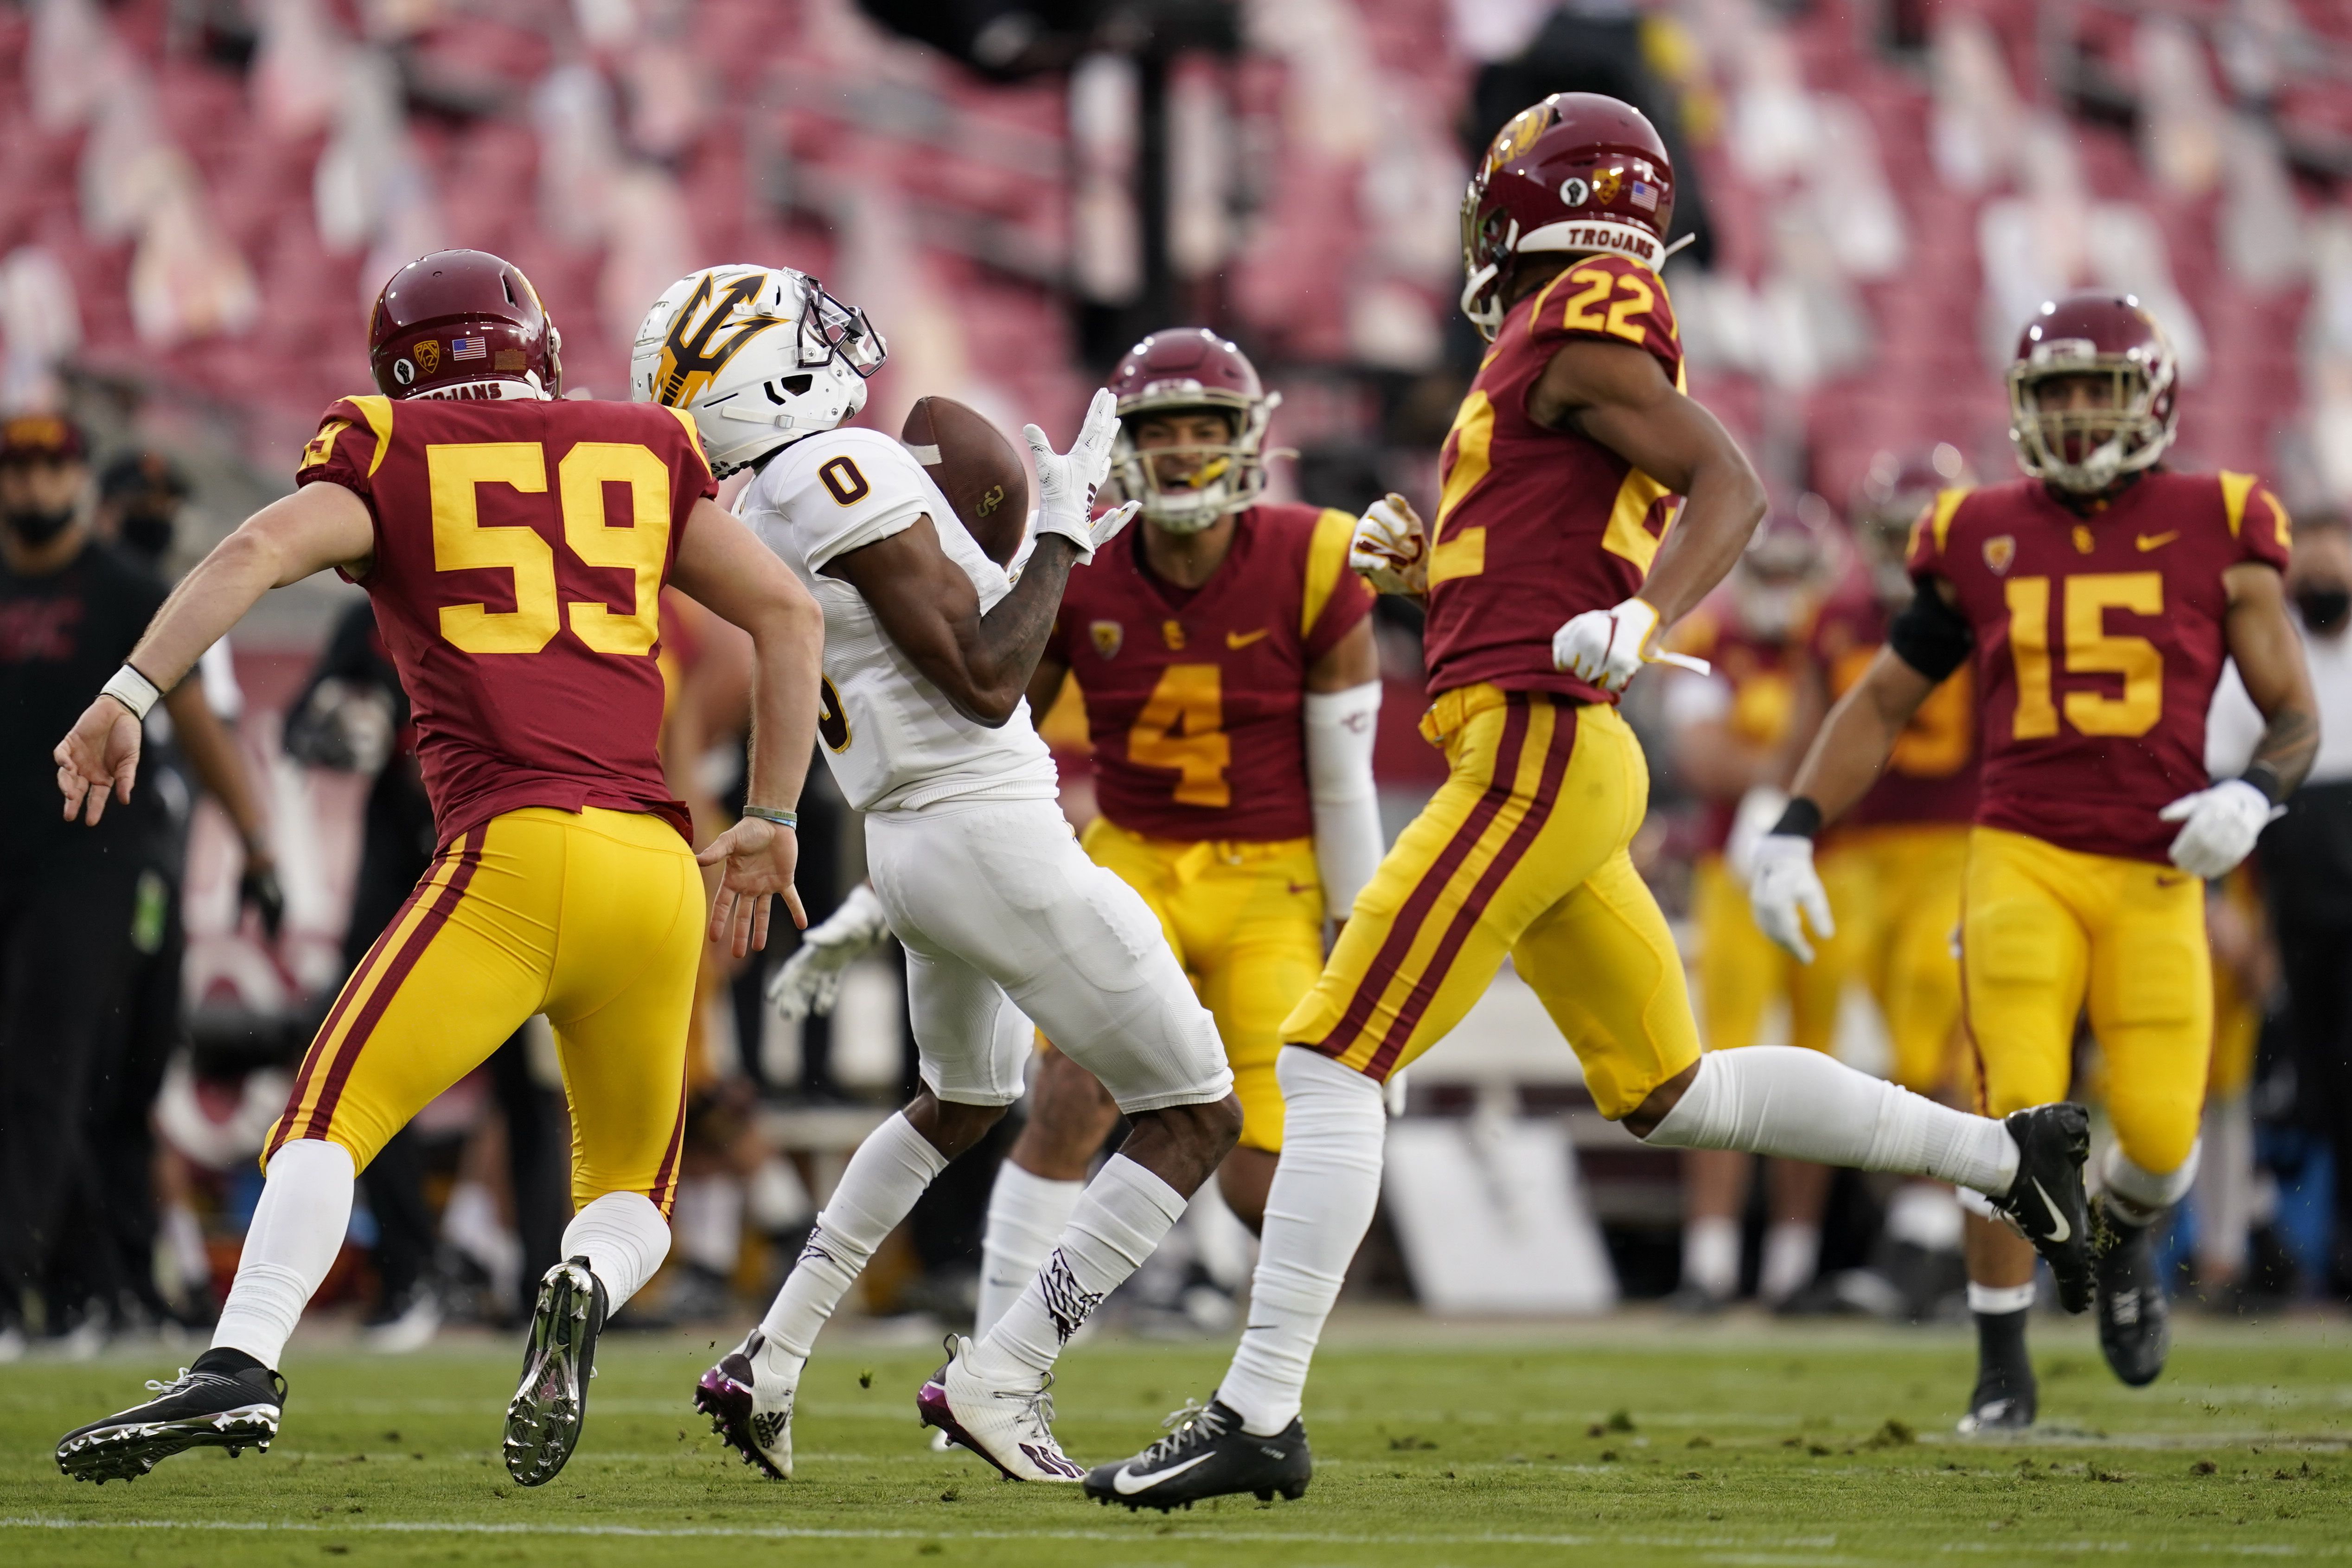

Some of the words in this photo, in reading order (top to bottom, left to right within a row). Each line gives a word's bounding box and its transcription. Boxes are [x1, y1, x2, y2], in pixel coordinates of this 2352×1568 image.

[1570, 229, 1655, 259] TROJANS
[1563, 268, 1654, 344] 22
[414, 341, 438, 362] PAC
[423, 355, 435, 367] 12
[817, 455, 871, 508] 0
[426, 442, 671, 656] 59
[2004, 570, 2164, 741] 15
[1127, 663, 1231, 807] 4
[753, 1413, 774, 1449] adidas
